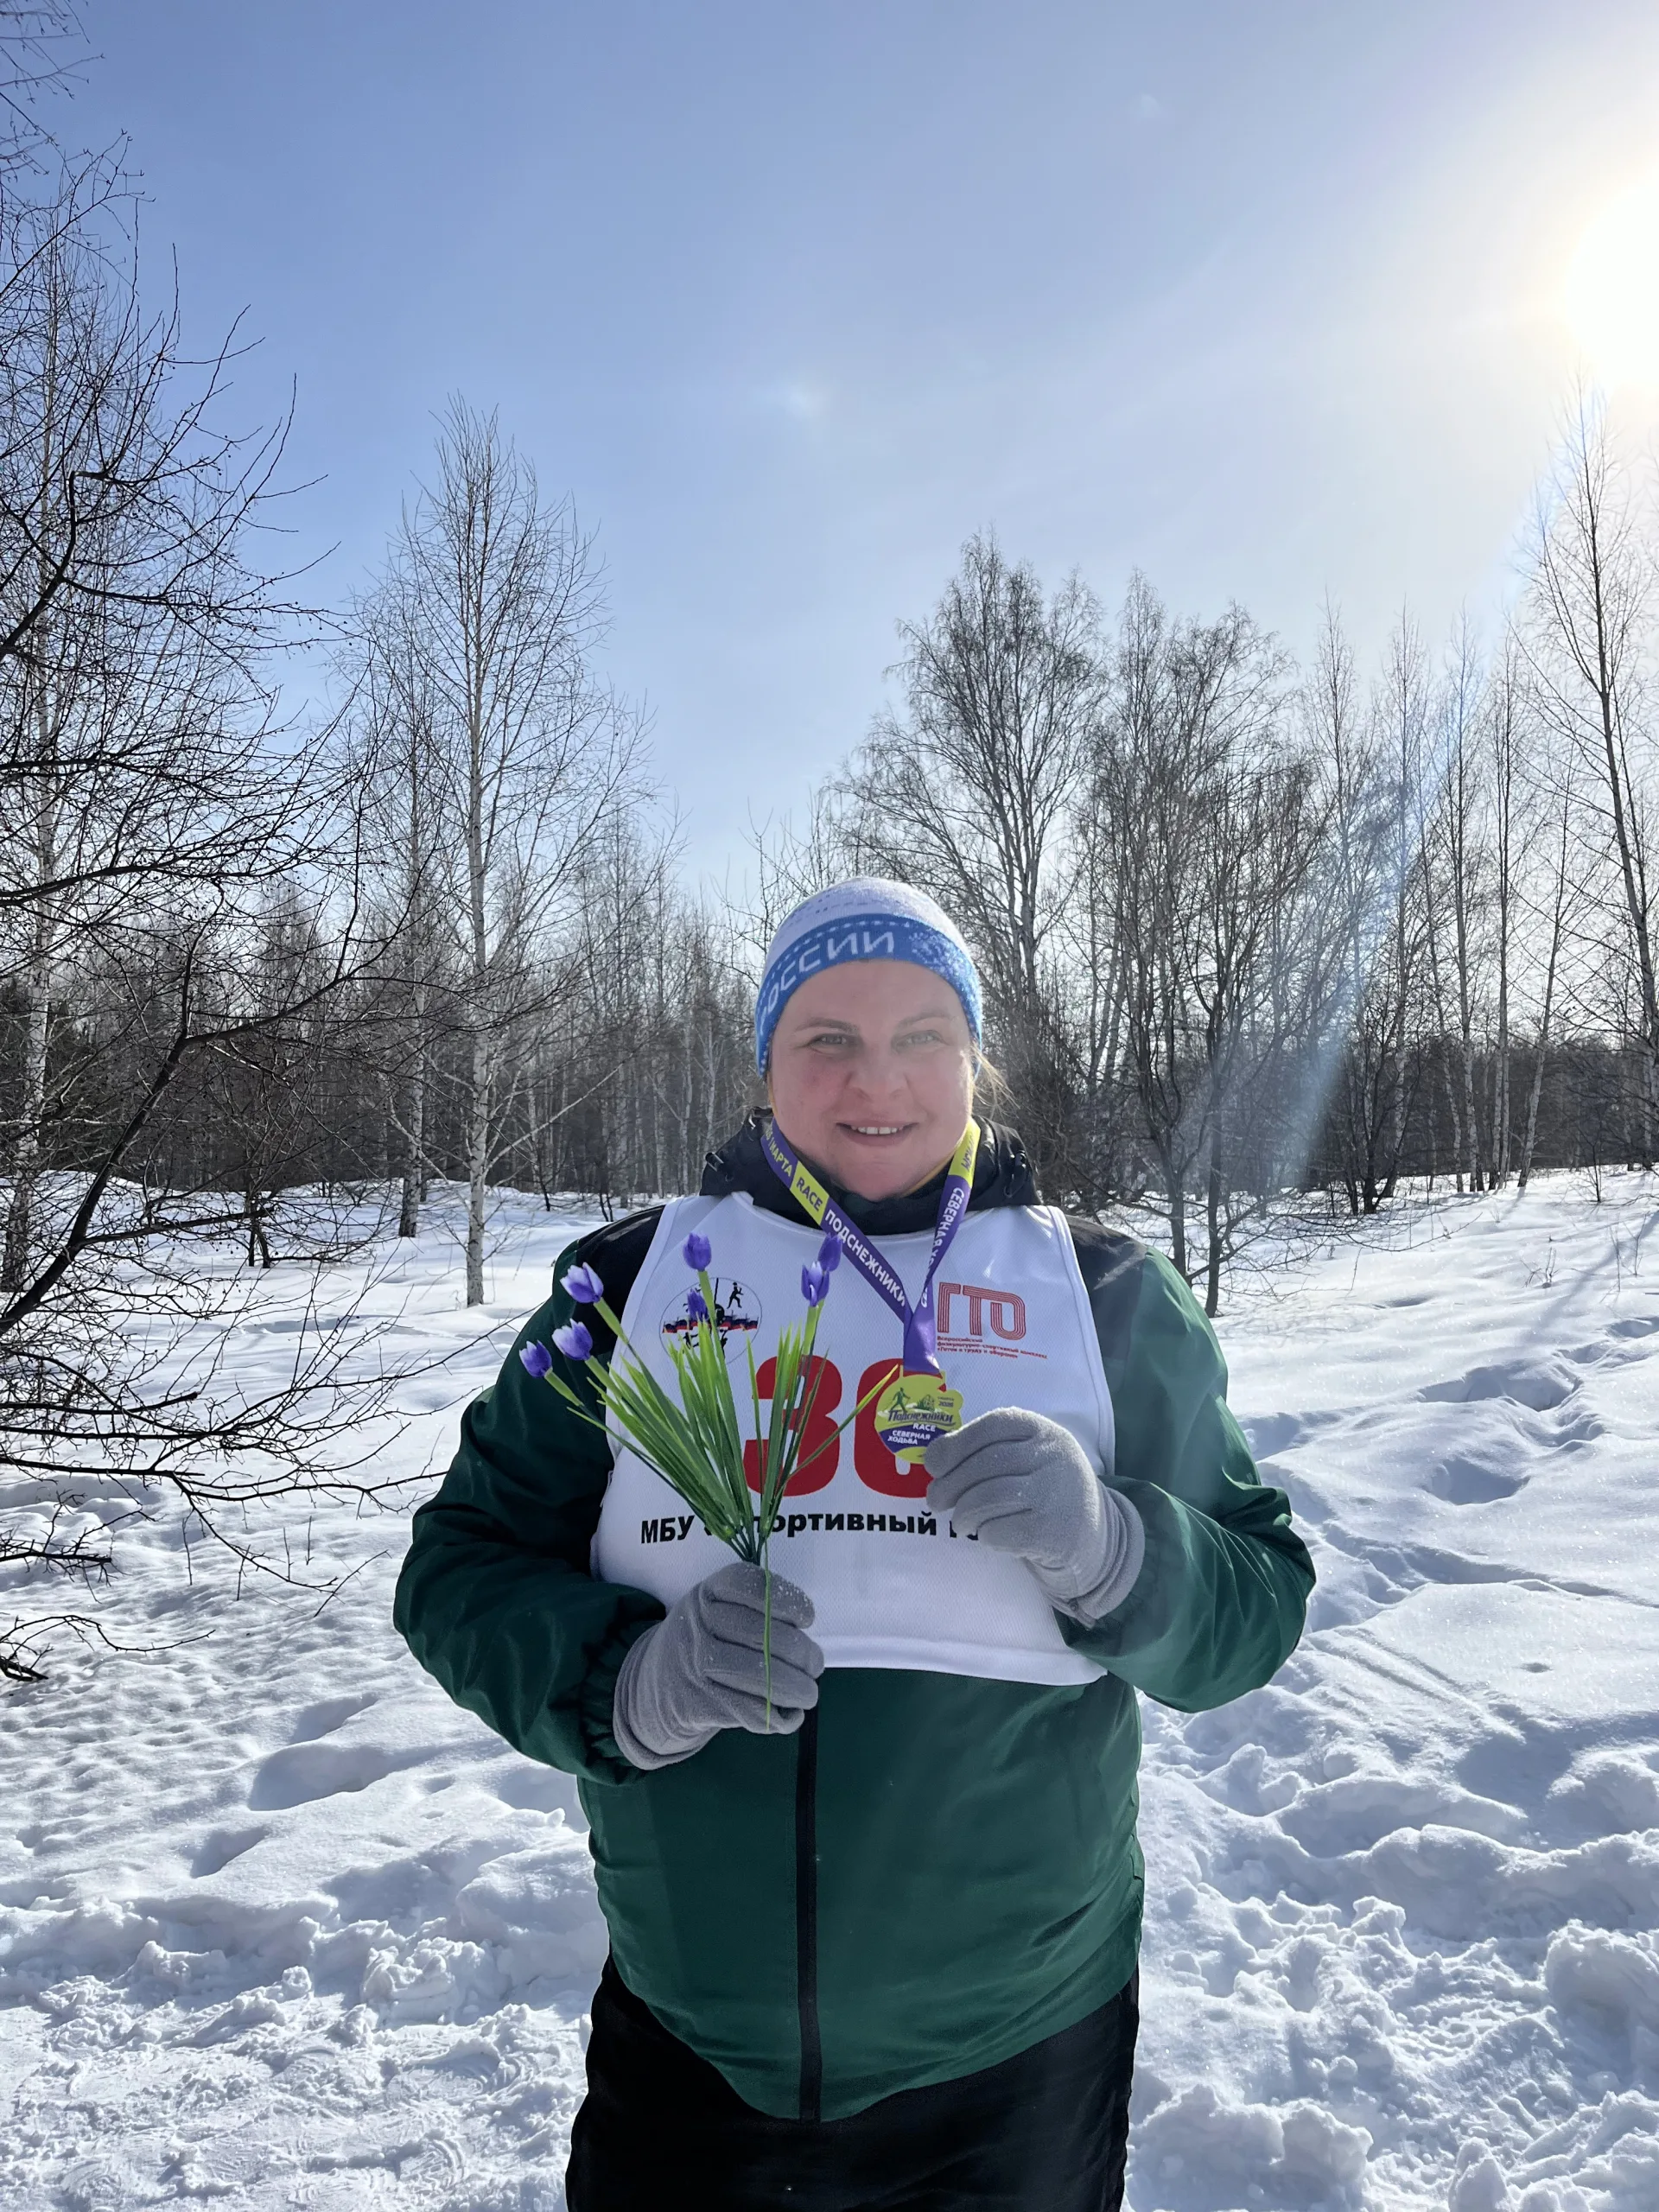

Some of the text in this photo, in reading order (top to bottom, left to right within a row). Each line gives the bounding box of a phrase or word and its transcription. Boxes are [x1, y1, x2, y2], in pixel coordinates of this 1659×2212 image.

[796, 1176, 823, 1212] RACE
[933, 1187, 965, 1248] СЕВЕРНАЯ
[824, 1209, 906, 1307] ПОДСНЕЖНИКИ
[938, 1282, 1027, 1340] ГТО
[887, 1435, 918, 1446] ХОДЬБА
[892, 1429, 931, 1440] СЕВЕРНАЯ
[912, 1422, 937, 1433] RACE
[641, 1515, 695, 1544] МБУ
[704, 1511, 937, 1538] ортивный
